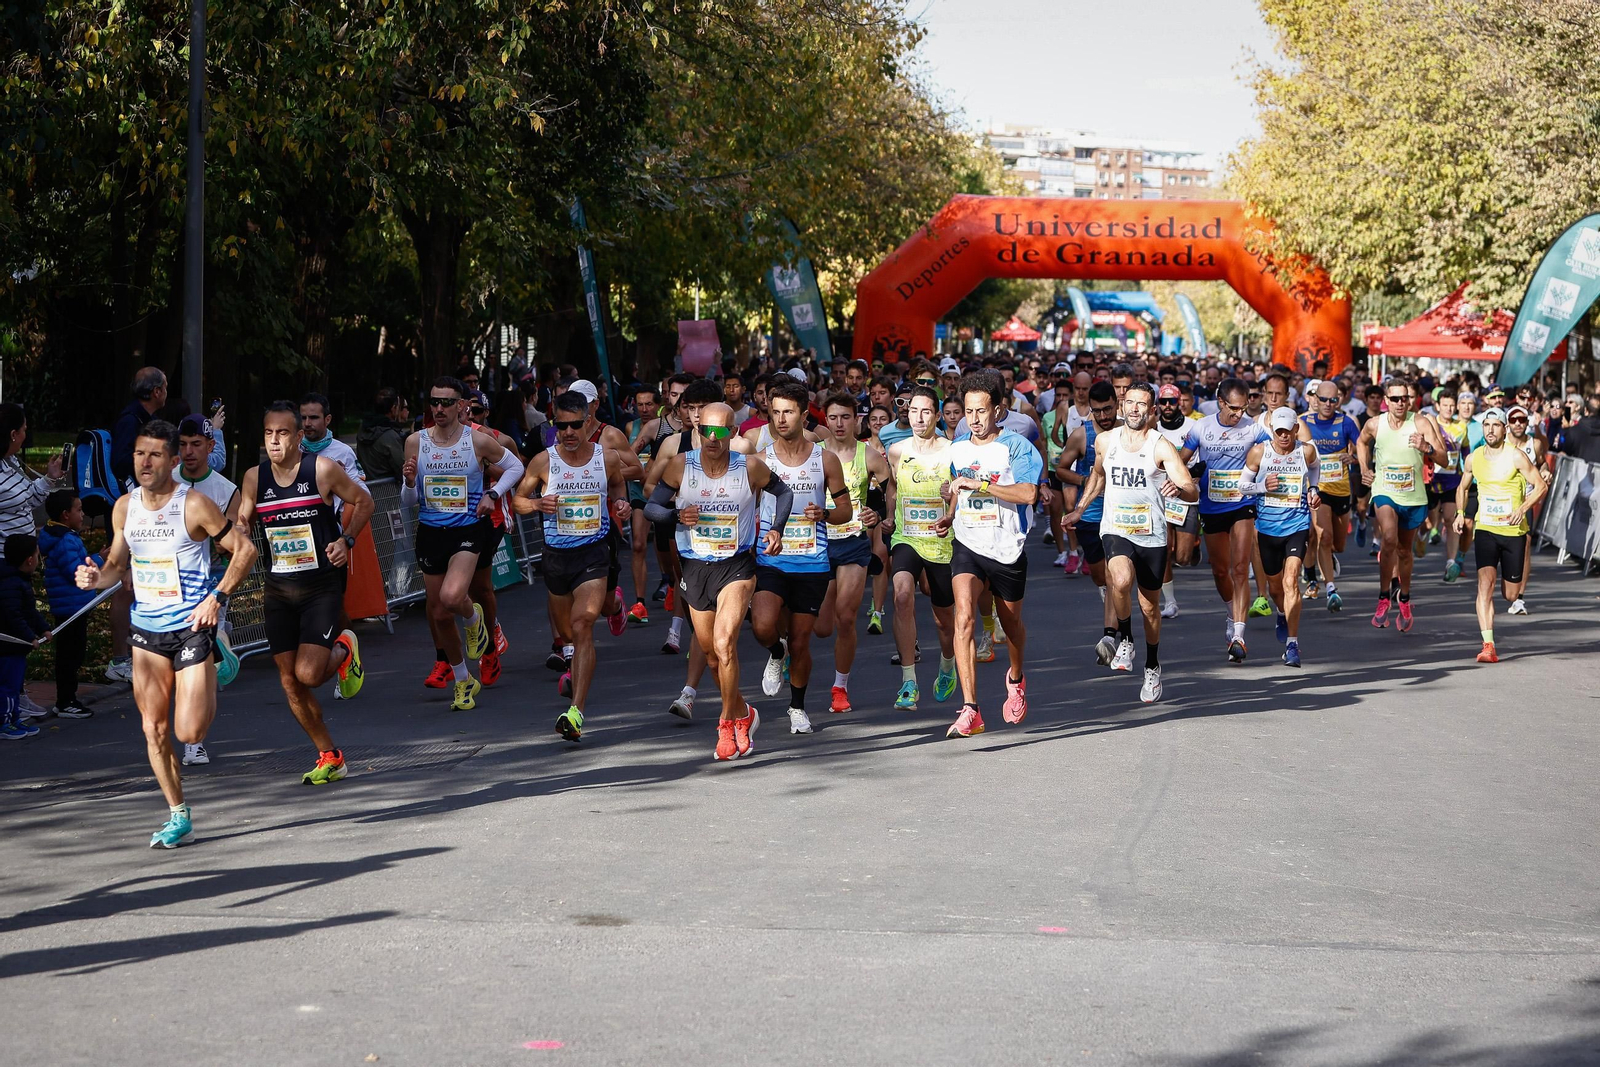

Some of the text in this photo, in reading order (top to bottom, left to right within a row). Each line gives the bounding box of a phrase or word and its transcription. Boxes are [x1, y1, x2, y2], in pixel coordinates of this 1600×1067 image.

[991, 213, 1223, 239] Universidad
[997, 241, 1216, 267] de Granada
[896, 237, 970, 301] Deportes
[426, 461, 469, 470] MARACENA
[1111, 466, 1147, 488] ENA
[556, 482, 601, 490] MARACENA
[432, 487, 460, 497] 926
[564, 507, 594, 518] 940
[696, 504, 740, 512] ARACENA
[1486, 505, 1505, 513] 241
[909, 509, 938, 520] 936
[1115, 514, 1147, 525] 1519
[130, 528, 175, 538] MARACENA
[696, 526, 732, 538] 1132
[273, 540, 308, 554] 1413
[136, 570, 168, 584] 973
